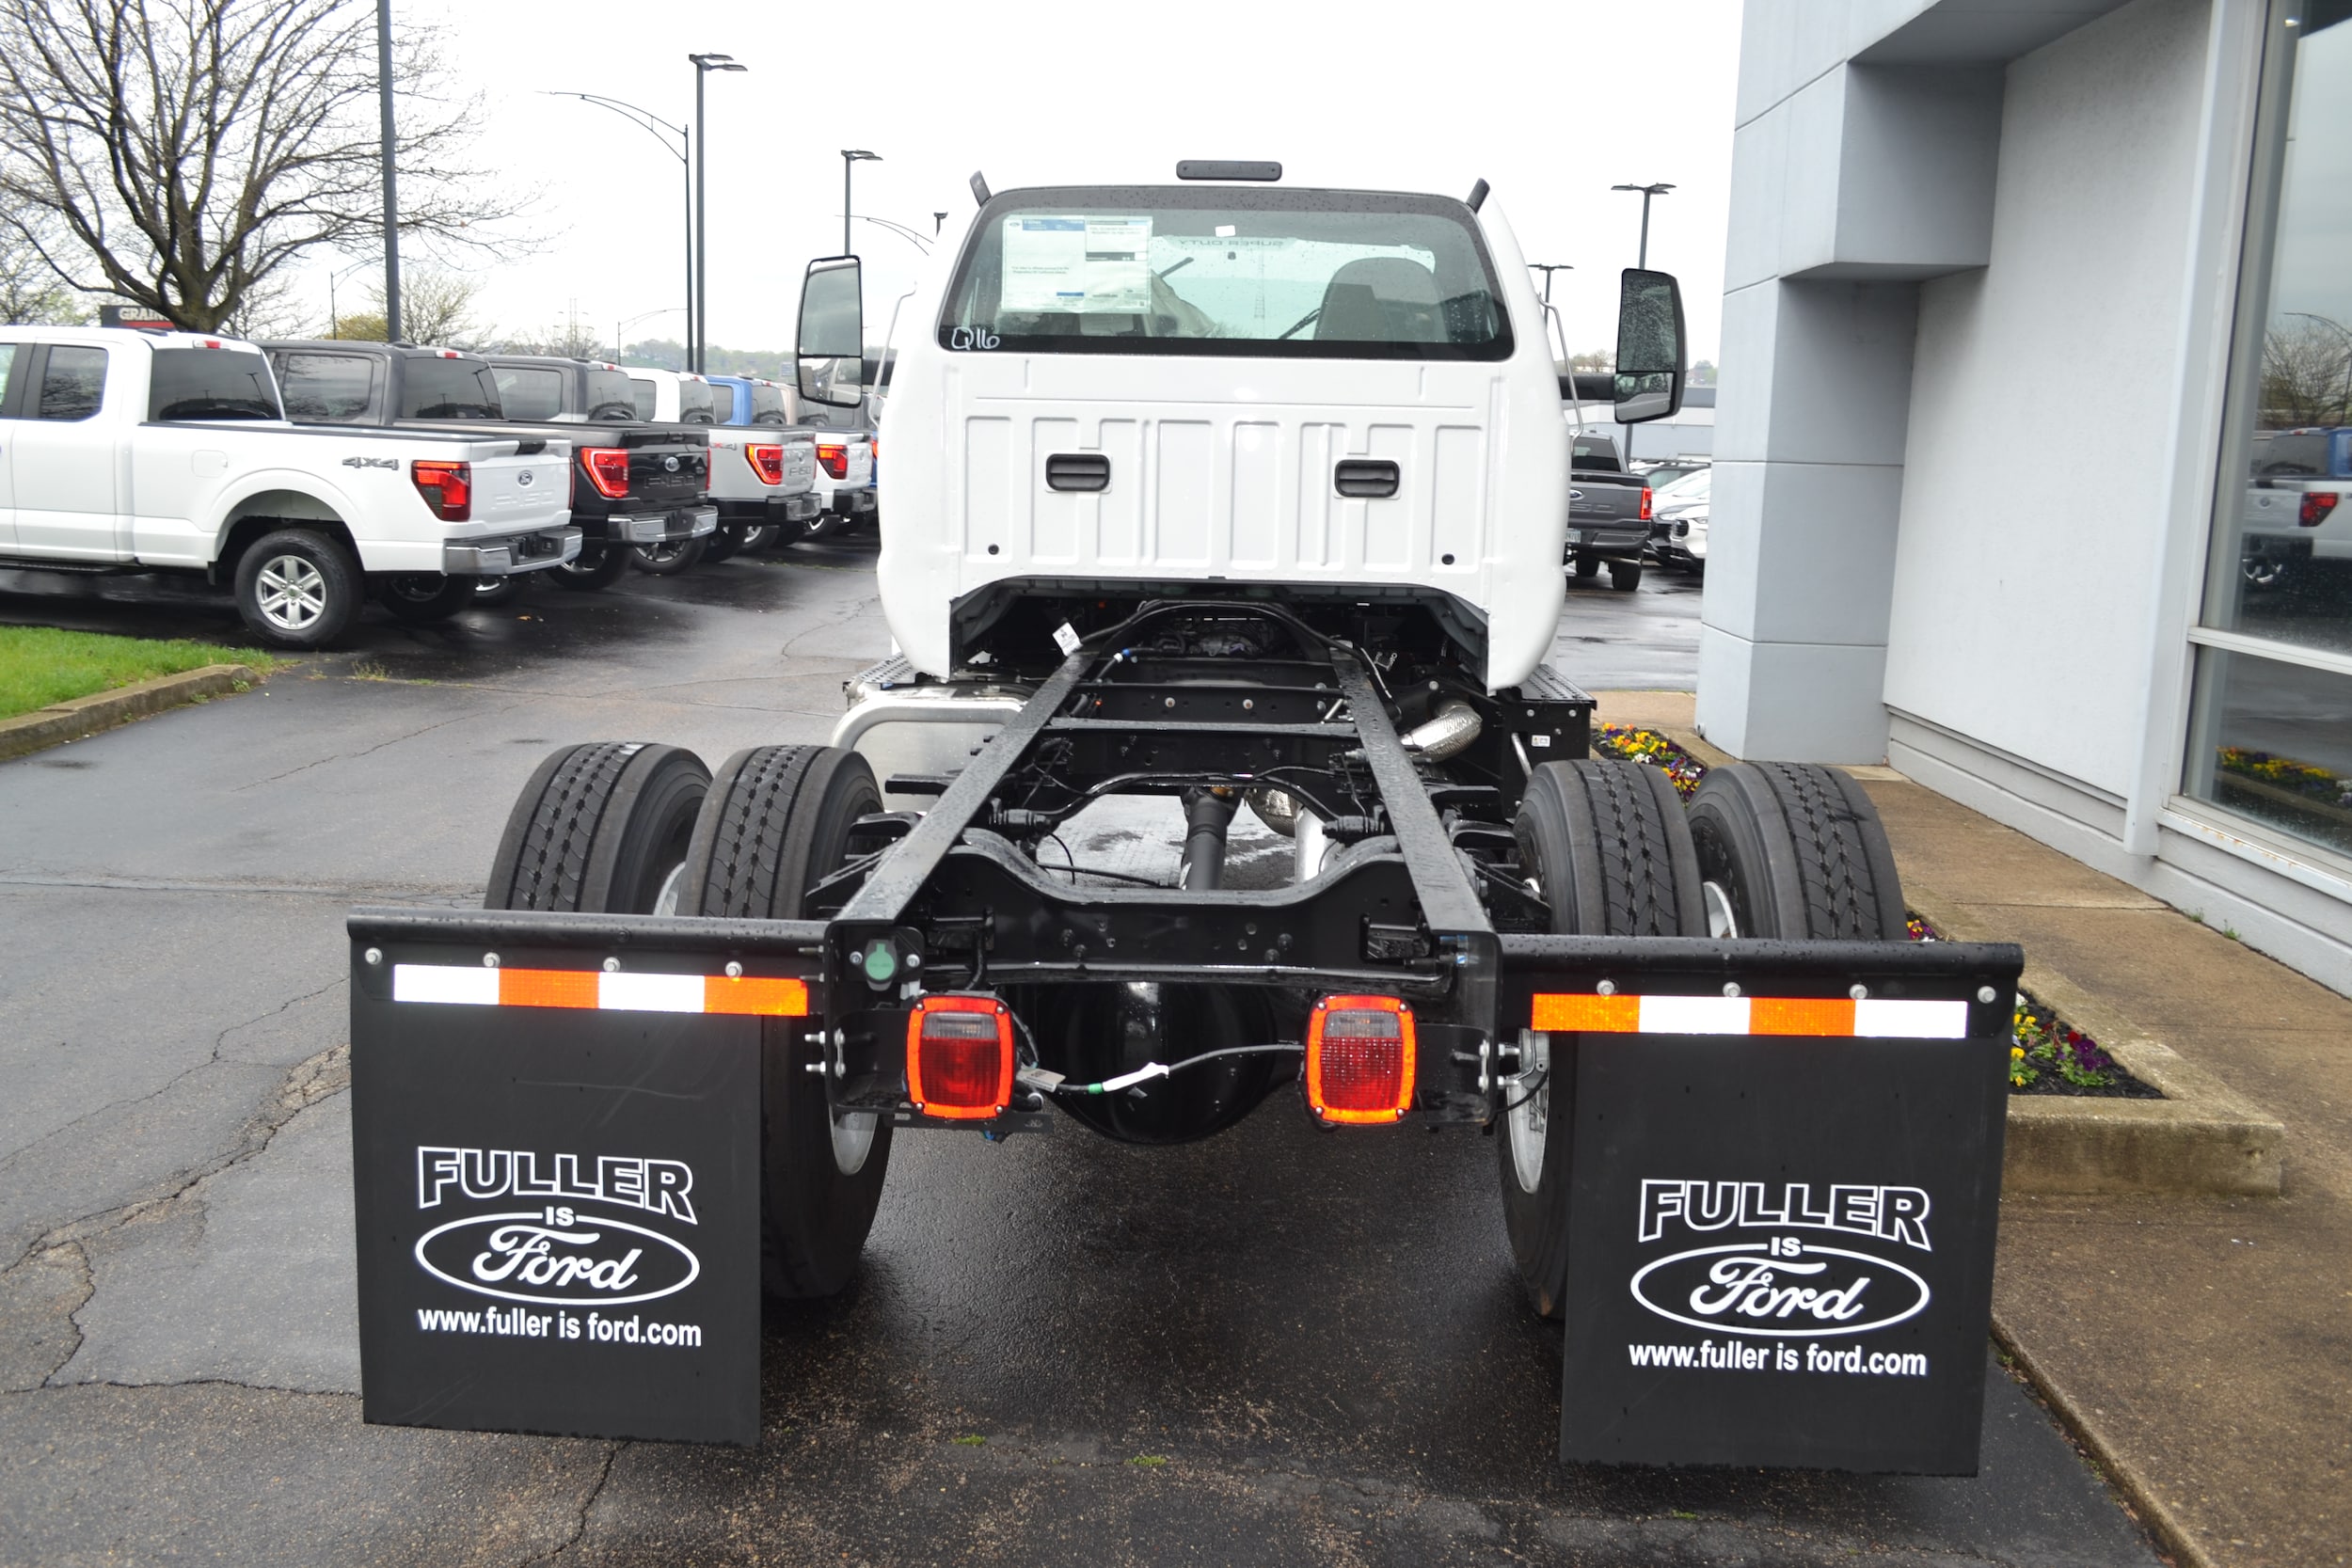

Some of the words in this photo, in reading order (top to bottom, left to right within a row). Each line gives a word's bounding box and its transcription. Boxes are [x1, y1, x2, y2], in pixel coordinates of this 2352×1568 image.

[951, 325, 1001, 351] Q16
[417, 1145, 699, 1226] FULLER
[545, 1205, 575, 1227] IS
[1637, 1178, 1932, 1252] FULLER
[472, 1225, 644, 1291] Ford
[1770, 1236, 1802, 1258] IS
[1689, 1256, 1871, 1321] Ford
[417, 1305, 553, 1338] www.fuller
[558, 1309, 581, 1339] is
[587, 1311, 702, 1348] ford.com
[1628, 1338, 1771, 1371] www.fuller
[1775, 1341, 1800, 1371] is
[1805, 1342, 1928, 1376] ford.com
